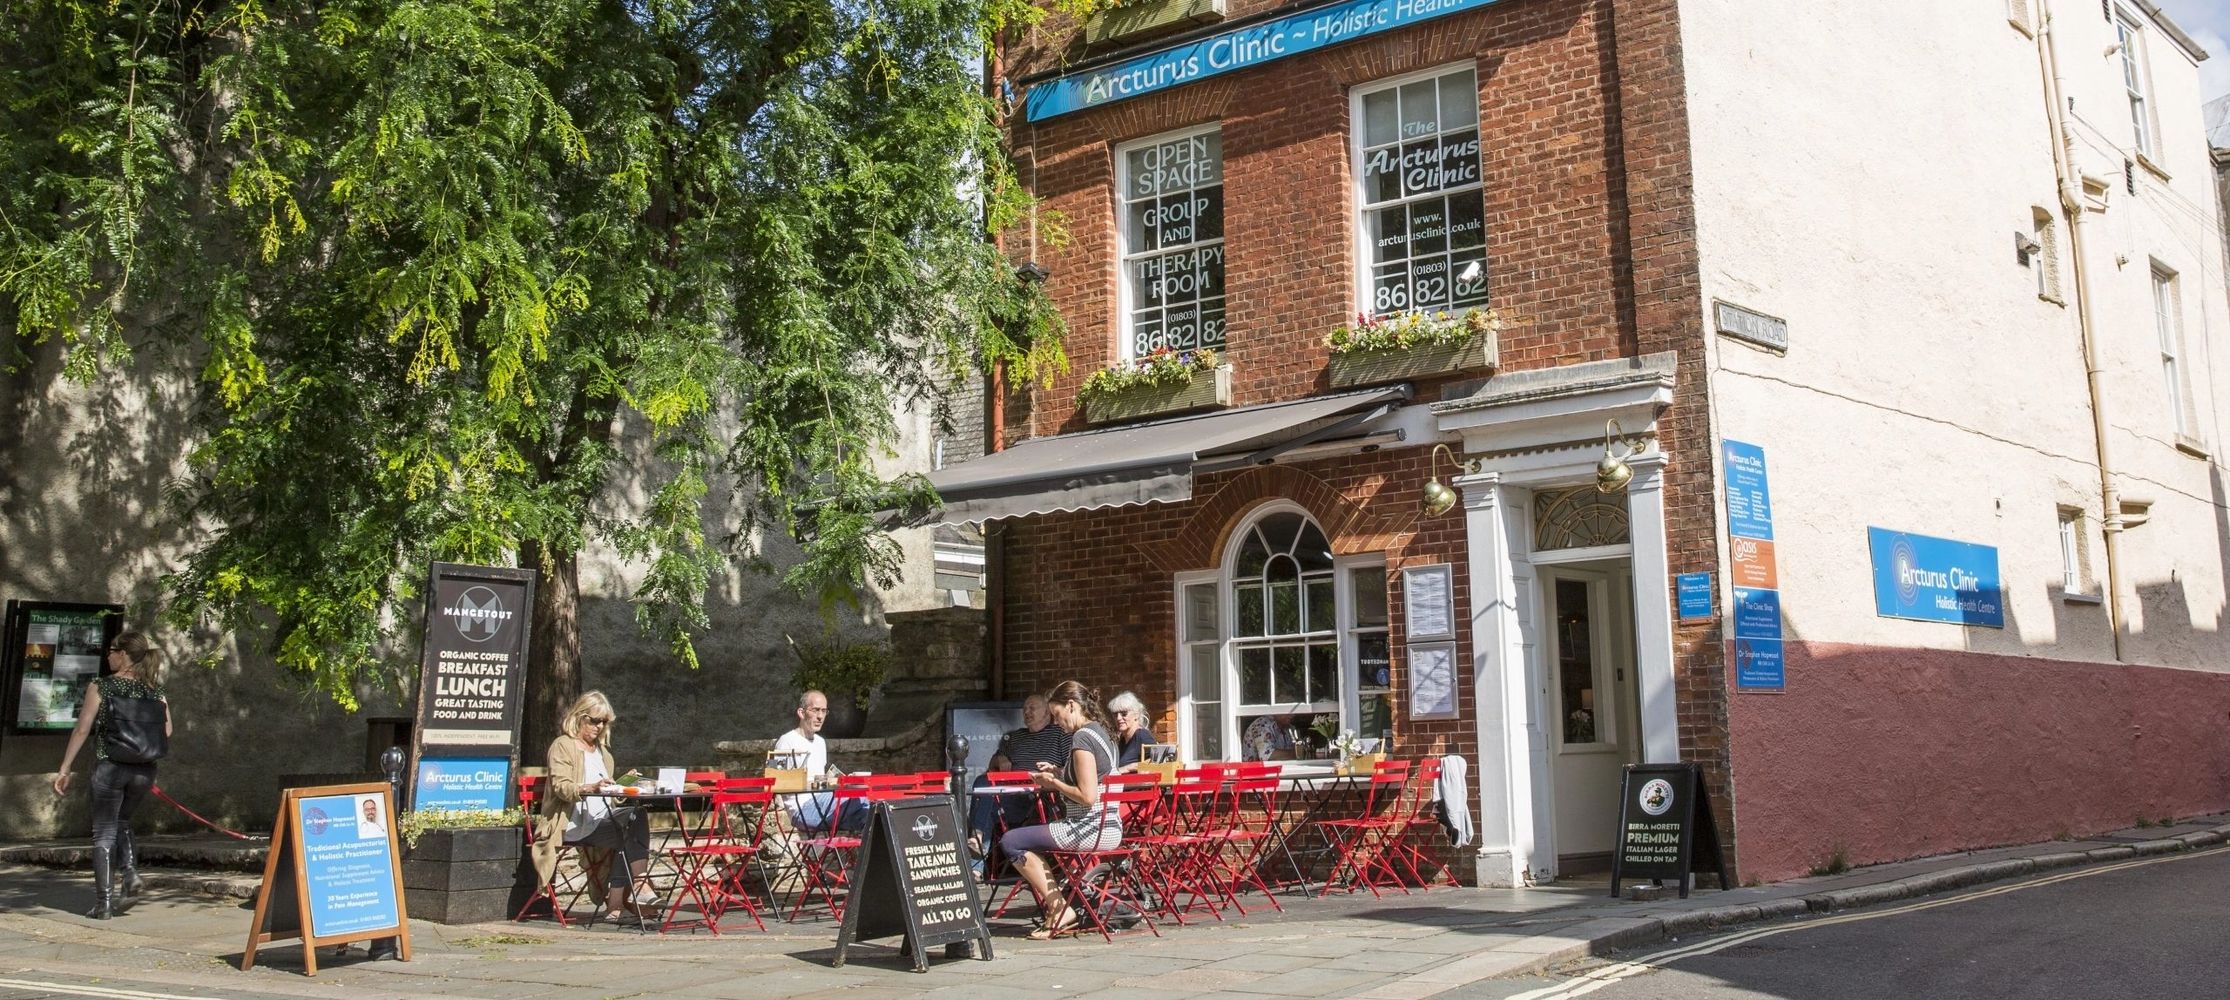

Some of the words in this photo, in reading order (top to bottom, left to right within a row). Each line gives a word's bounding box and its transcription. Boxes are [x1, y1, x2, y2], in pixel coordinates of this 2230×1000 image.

[1087, 55, 1199, 103] Arcturus
[1208, 28, 1285, 68] Clinic
[1313, 5, 1389, 42] Holistic
[1403, 120, 1436, 136] The
[1143, 137, 1208, 170] OPEN
[1365, 139, 1479, 177] Arcturus
[1138, 158, 1214, 194] SPACE
[1406, 160, 1477, 191] Clinic
[1143, 198, 1209, 227] GROUP
[1413, 213, 1442, 225] www.
[1163, 225, 1193, 243] AND
[1137, 246, 1224, 279] THERAPY
[1412, 260, 1447, 277] (01803)
[1151, 270, 1211, 299] ROOM
[1375, 283, 1407, 310] 86
[1415, 276, 1446, 303] 82
[1455, 270, 1487, 297] 82
[1167, 309, 1197, 324] (01803)
[1722, 309, 1759, 335] STATION
[1761, 321, 1786, 342] ROAD
[1135, 330, 1162, 356] 86
[1169, 324, 1196, 349] 82
[1901, 559, 1948, 589] Arcturus
[1950, 567, 1979, 593] Clinic
[1935, 594, 1958, 611] Holistic
[1958, 597, 1977, 612] Health
[1977, 599, 1996, 615] Centre
[32, 614, 47, 623] The
[48, 615, 73, 625] Shady
[74, 616, 101, 625] Gden
[443, 606, 513, 620] MANGETOUT
[440, 650, 479, 660] ORGANIC
[480, 652, 509, 662] COFFEE
[438, 661, 508, 676] BREAKFAST
[436, 677, 507, 697] LUNCH
[434, 698, 466, 708] GREAT
[468, 699, 505, 709] TASTING
[433, 710, 458, 719] FOOD
[458, 711, 477, 720] AND
[478, 711, 503, 720] DRINK
[425, 771, 472, 783] Arcturus
[474, 771, 503, 783] Clinic
[443, 783, 464, 791] Holistic
[1650, 823, 1680, 831] MORETTI
[1627, 832, 1680, 844] PREMIUM
[307, 843, 341, 853] Traditional
[319, 852, 345, 861] Holistic
[346, 849, 383, 859] Practitioner
[904, 844, 934, 856] FRESHLY
[935, 842, 956, 852] MADE
[1626, 845, 1653, 853] ITALIAN
[907, 852, 957, 869] TAKEAWAY
[1664, 855, 1678, 863] TAP
[910, 865, 961, 881] SANDWICHES
[913, 883, 942, 894] SEASONAL
[943, 880, 965, 890] SALADS
[916, 897, 945, 907] ORGANIC
[945, 892, 968, 904] COFFEE
[922, 911, 940, 926] ALL
[941, 909, 955, 922] TO
[956, 906, 971, 920] GO
